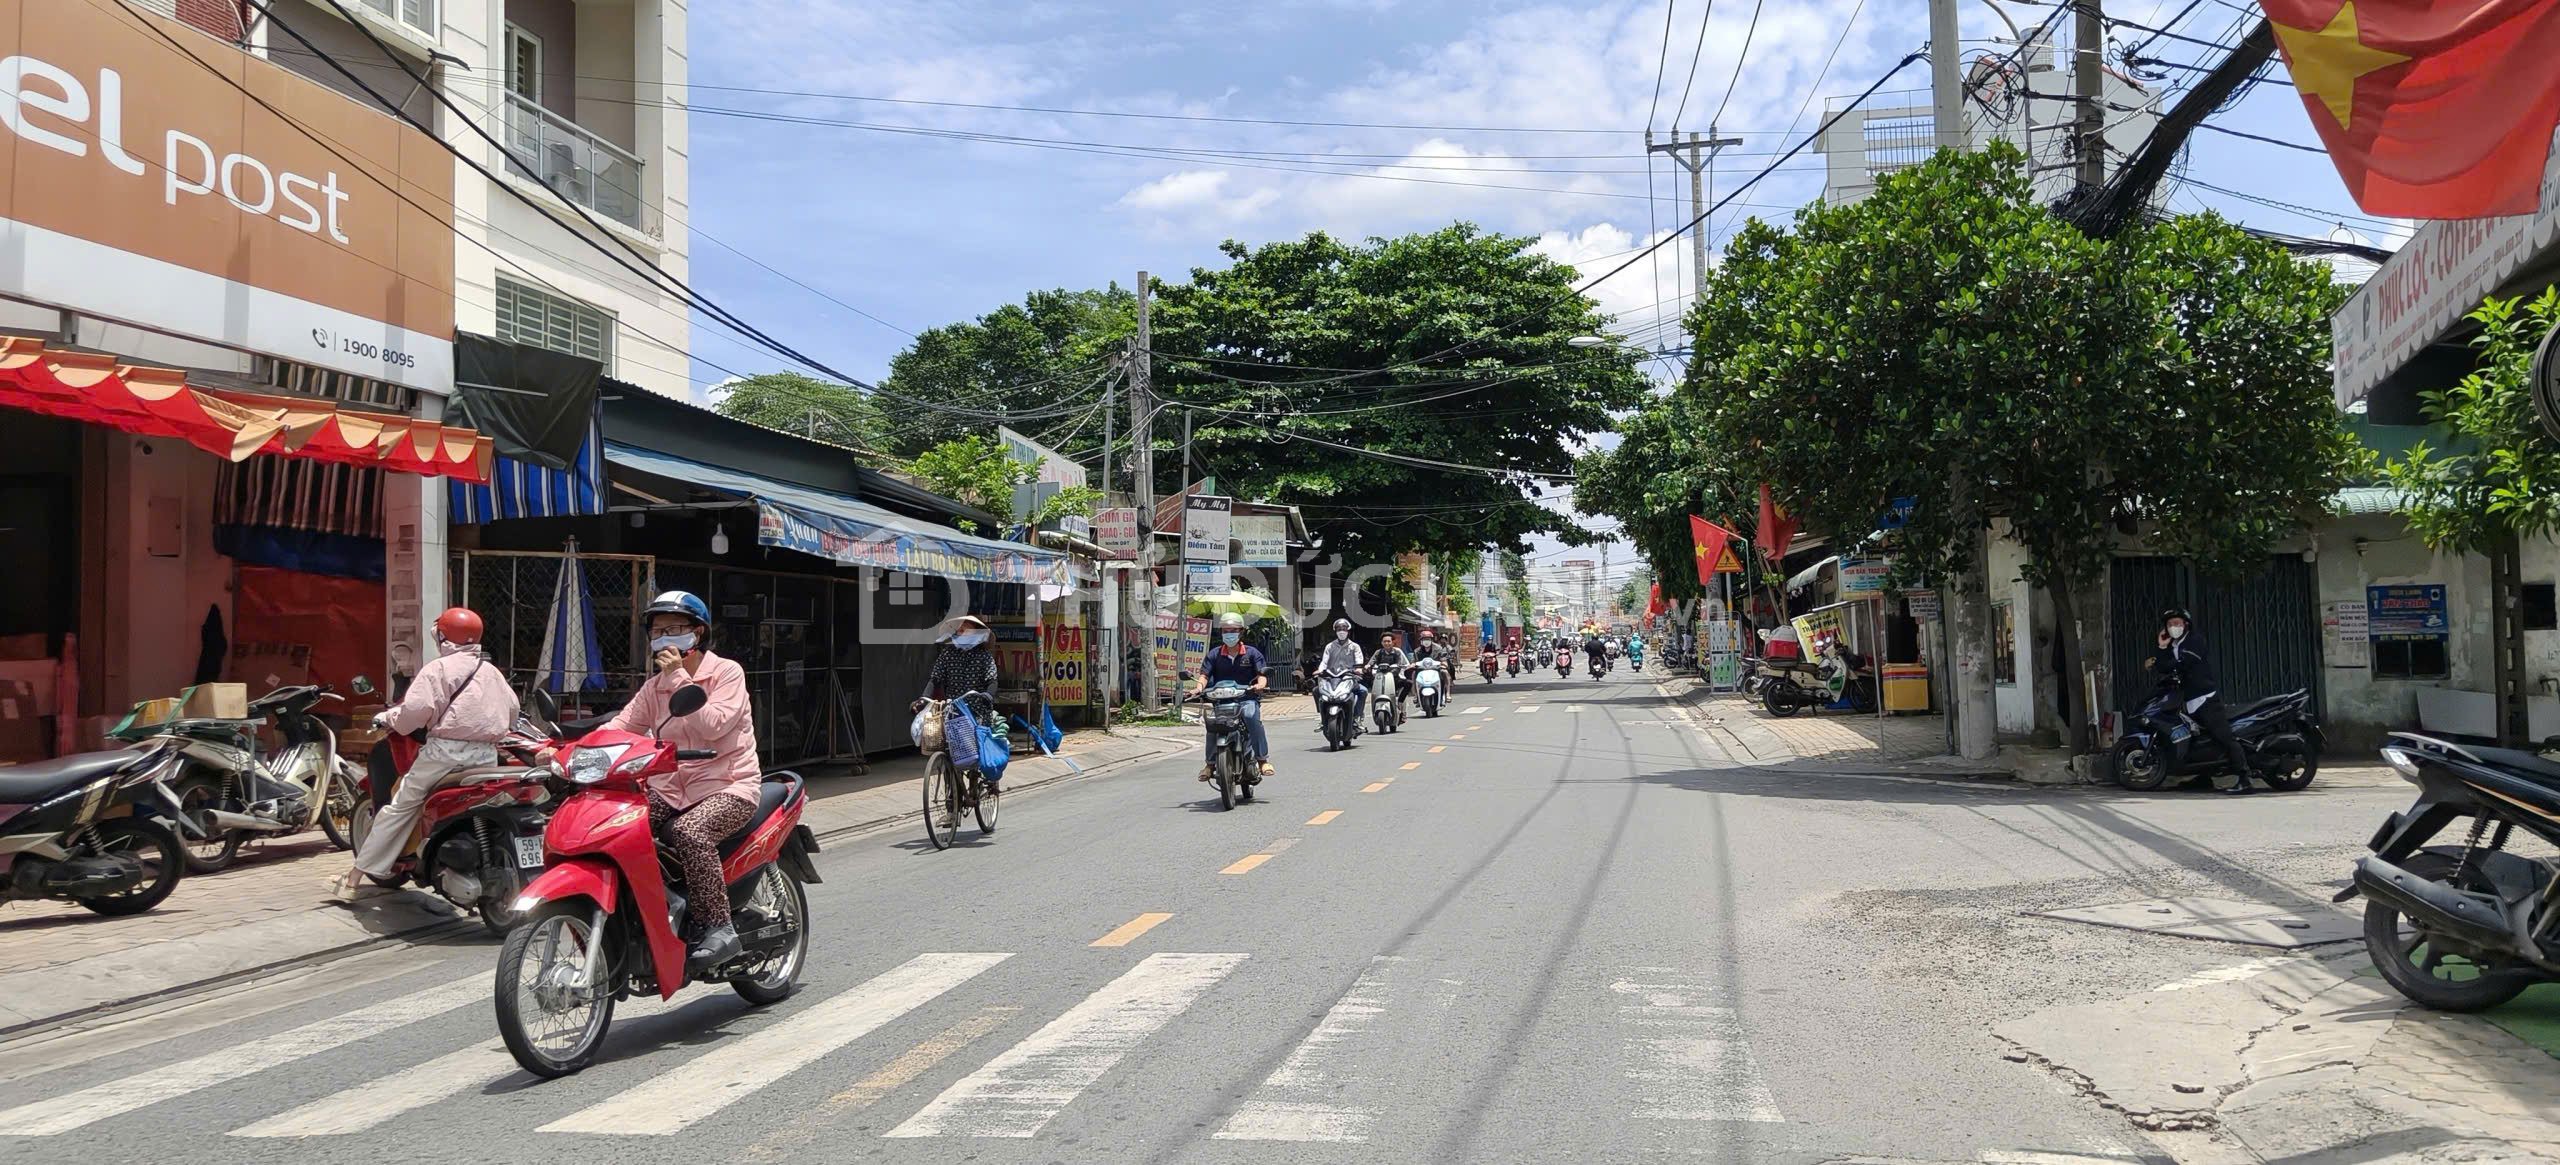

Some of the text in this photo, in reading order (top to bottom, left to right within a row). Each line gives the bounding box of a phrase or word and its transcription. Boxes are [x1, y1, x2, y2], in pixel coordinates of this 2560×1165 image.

[165, 128, 351, 246] post
[2378, 263, 2404, 336] PHÚC
[2407, 238, 2430, 314] LỘC
[343, 337, 416, 369] 1900 8095
[948, 556, 978, 576] MANG
[1192, 622, 1208, 633] 92
[1054, 656, 1082, 681] GỎI
[1053, 683, 1083, 701] CÚNG
